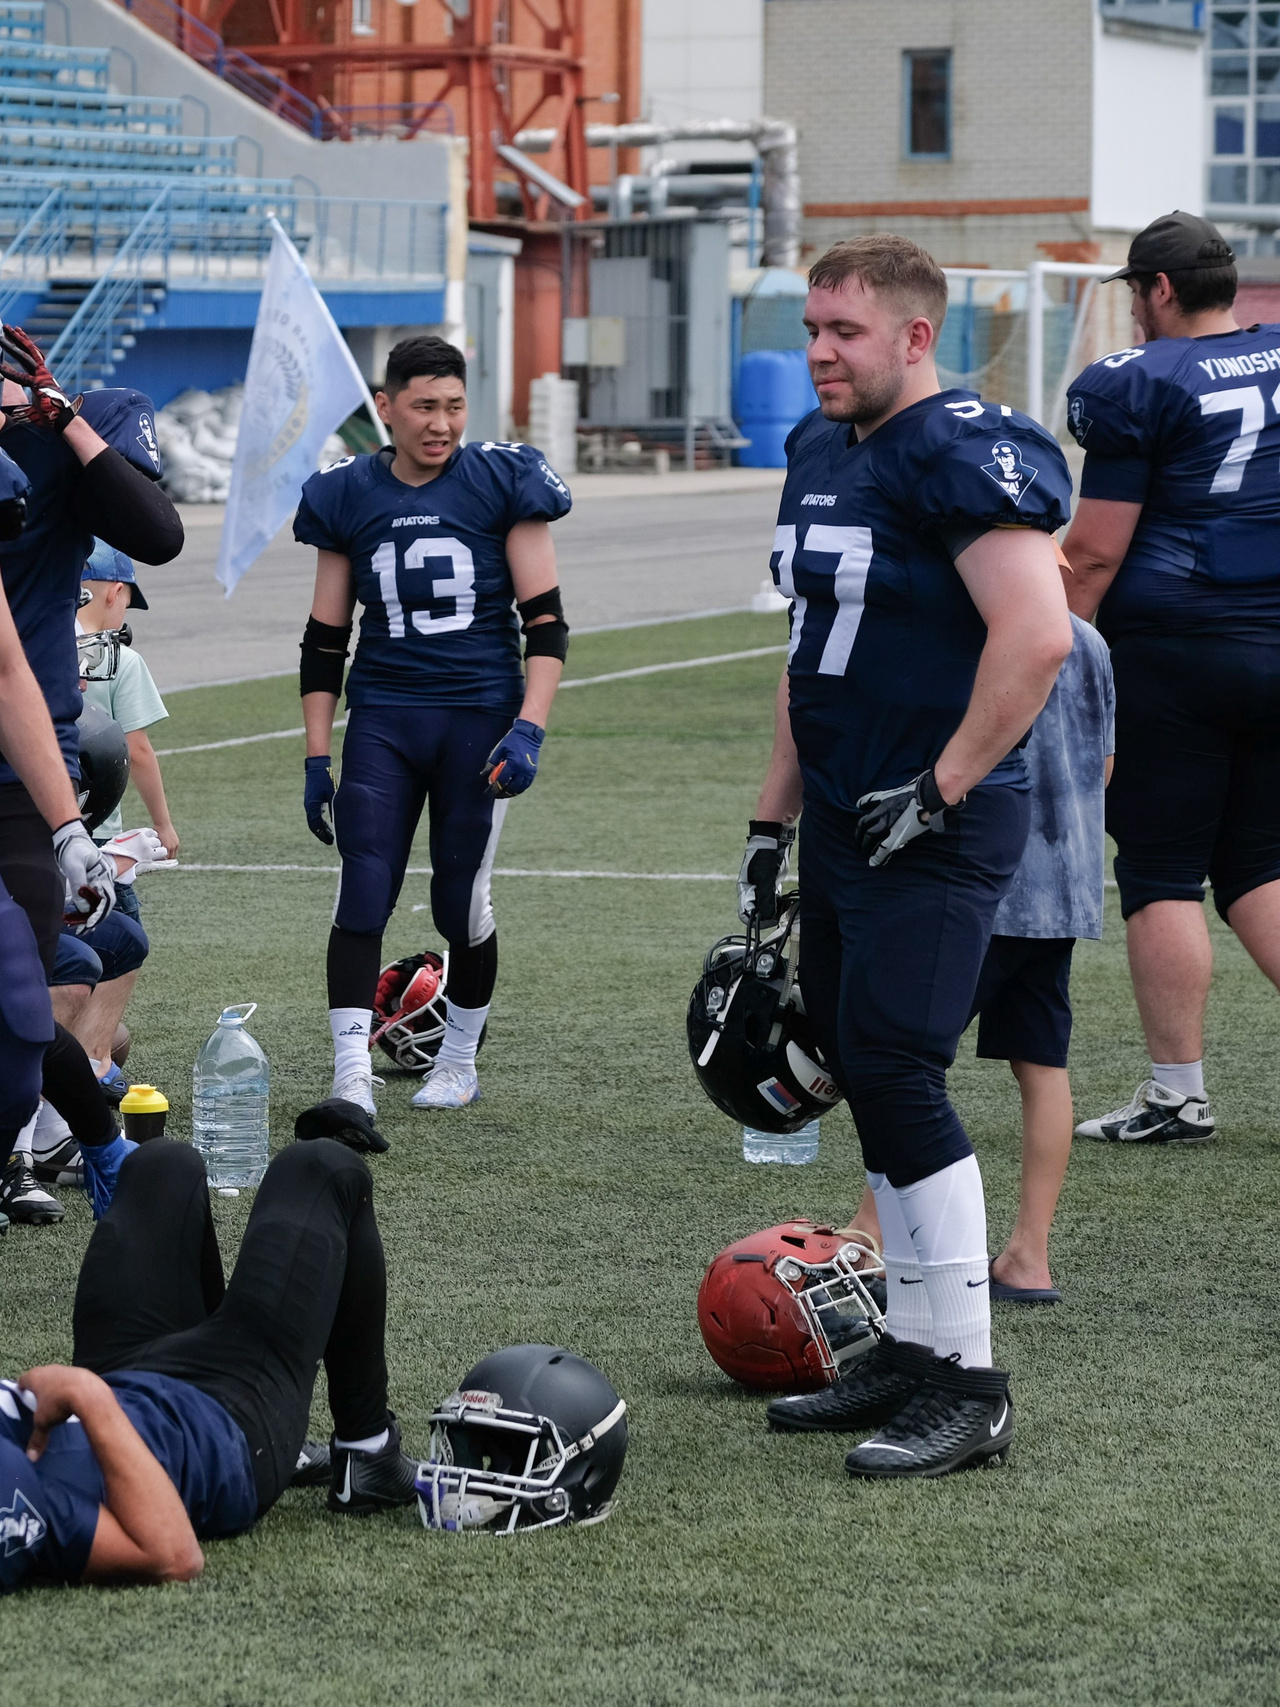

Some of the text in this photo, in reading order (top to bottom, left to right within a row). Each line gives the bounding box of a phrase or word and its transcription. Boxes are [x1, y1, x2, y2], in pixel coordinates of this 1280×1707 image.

[1197, 346, 1280, 381] YUNOSH
[1198, 385, 1280, 494] 7
[800, 493, 838, 507] AVIATORS
[391, 515, 440, 528] AVIATORS
[371, 536, 476, 638] 13
[1197, 1106, 1211, 1122] NI
